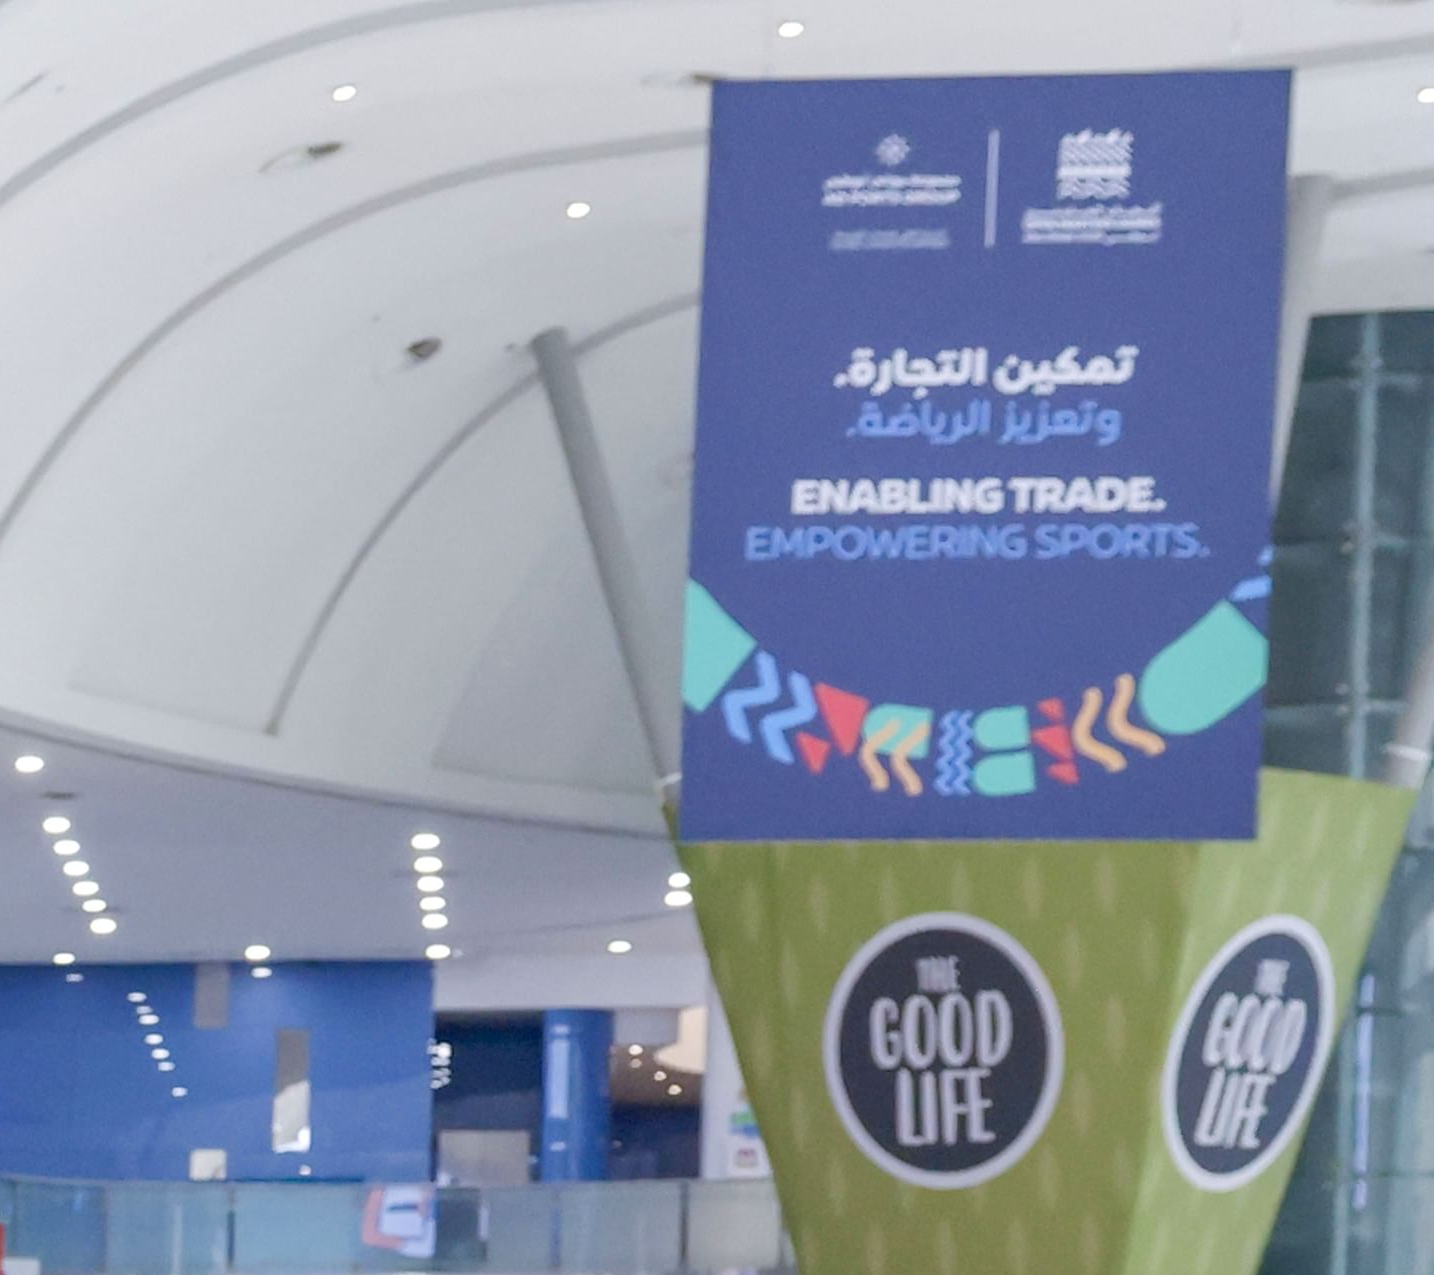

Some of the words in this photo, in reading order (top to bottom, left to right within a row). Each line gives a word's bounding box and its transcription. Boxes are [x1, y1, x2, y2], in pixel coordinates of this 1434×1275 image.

[993, 346, 1140, 395] تمكين
[998, 400, 1124, 447] وتعزيز
[791, 478, 1004, 514] ENABLING
[1010, 476, 1167, 513] TRADE.
[745, 524, 1027, 561] EMPOWERING
[1034, 522, 1211, 560] SPORTS.
[915, 956, 962, 993] THE
[869, 990, 1013, 1071] GOOD
[1202, 992, 1306, 1076] GOOD
[895, 1067, 996, 1147] LIFE
[1193, 1067, 1276, 1149] LIFE
